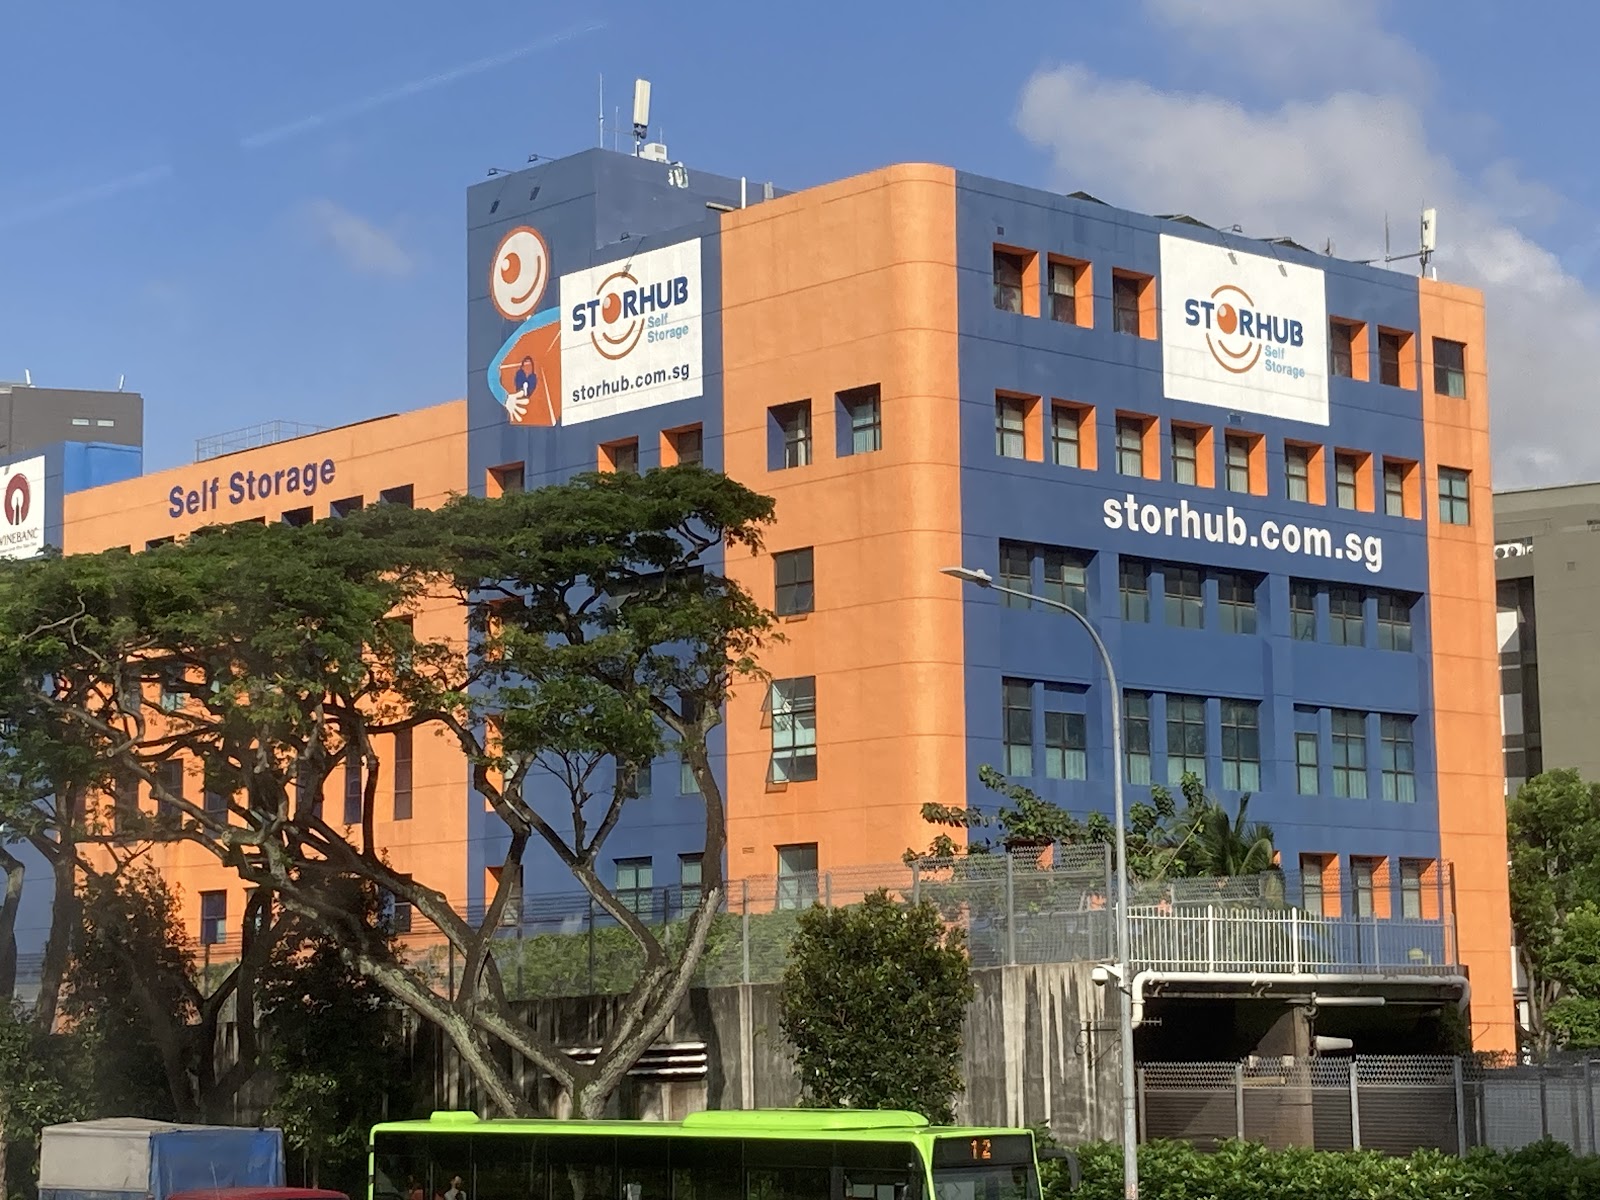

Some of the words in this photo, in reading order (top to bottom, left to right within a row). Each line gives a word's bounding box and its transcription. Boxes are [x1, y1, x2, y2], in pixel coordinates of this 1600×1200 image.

[572, 276, 688, 332] STORHUB
[647, 312, 668, 329] Self
[647, 325, 689, 343] Storage
[1185, 298, 1303, 348] STORHUB
[1264, 344, 1285, 360] Self
[572, 363, 690, 402] storhub.com.sg
[1264, 359, 1305, 378] Storage
[169, 477, 219, 518] Self
[229, 459, 336, 505] Storage
[1103, 494, 1382, 573] storhub.com.sg
[971, 1139, 992, 1160] 12
